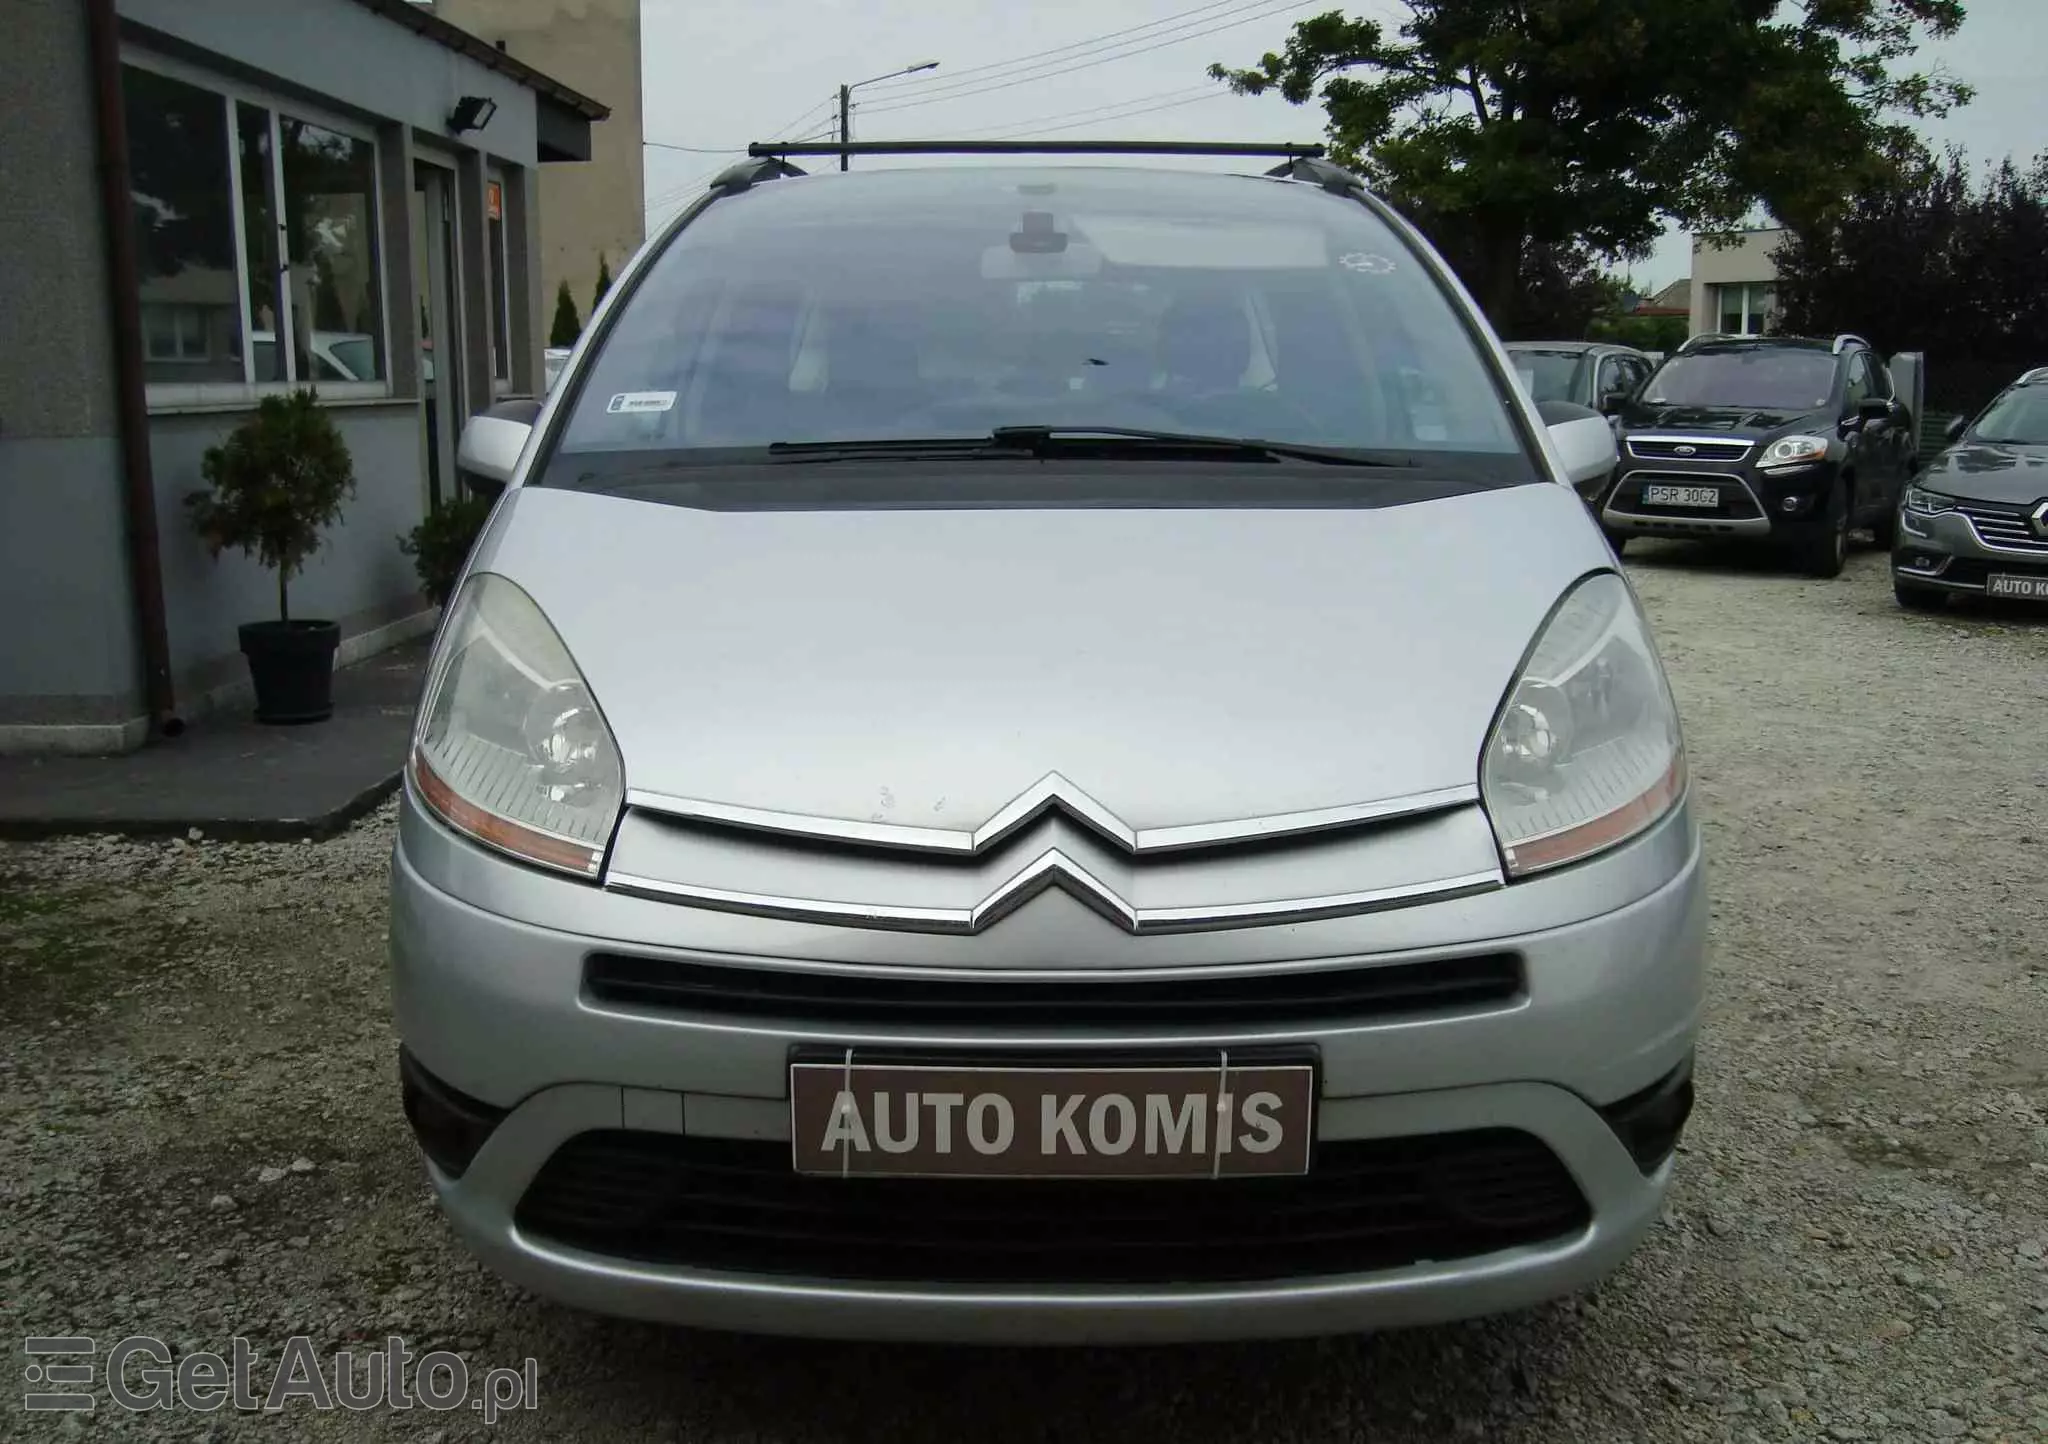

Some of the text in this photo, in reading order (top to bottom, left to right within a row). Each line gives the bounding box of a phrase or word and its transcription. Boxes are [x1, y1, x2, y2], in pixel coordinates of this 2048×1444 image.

[1650, 487, 1679, 501] PSR
[1992, 579, 2048, 596] AUTO K
[821, 1091, 1284, 1156] AUTO KOMIS
